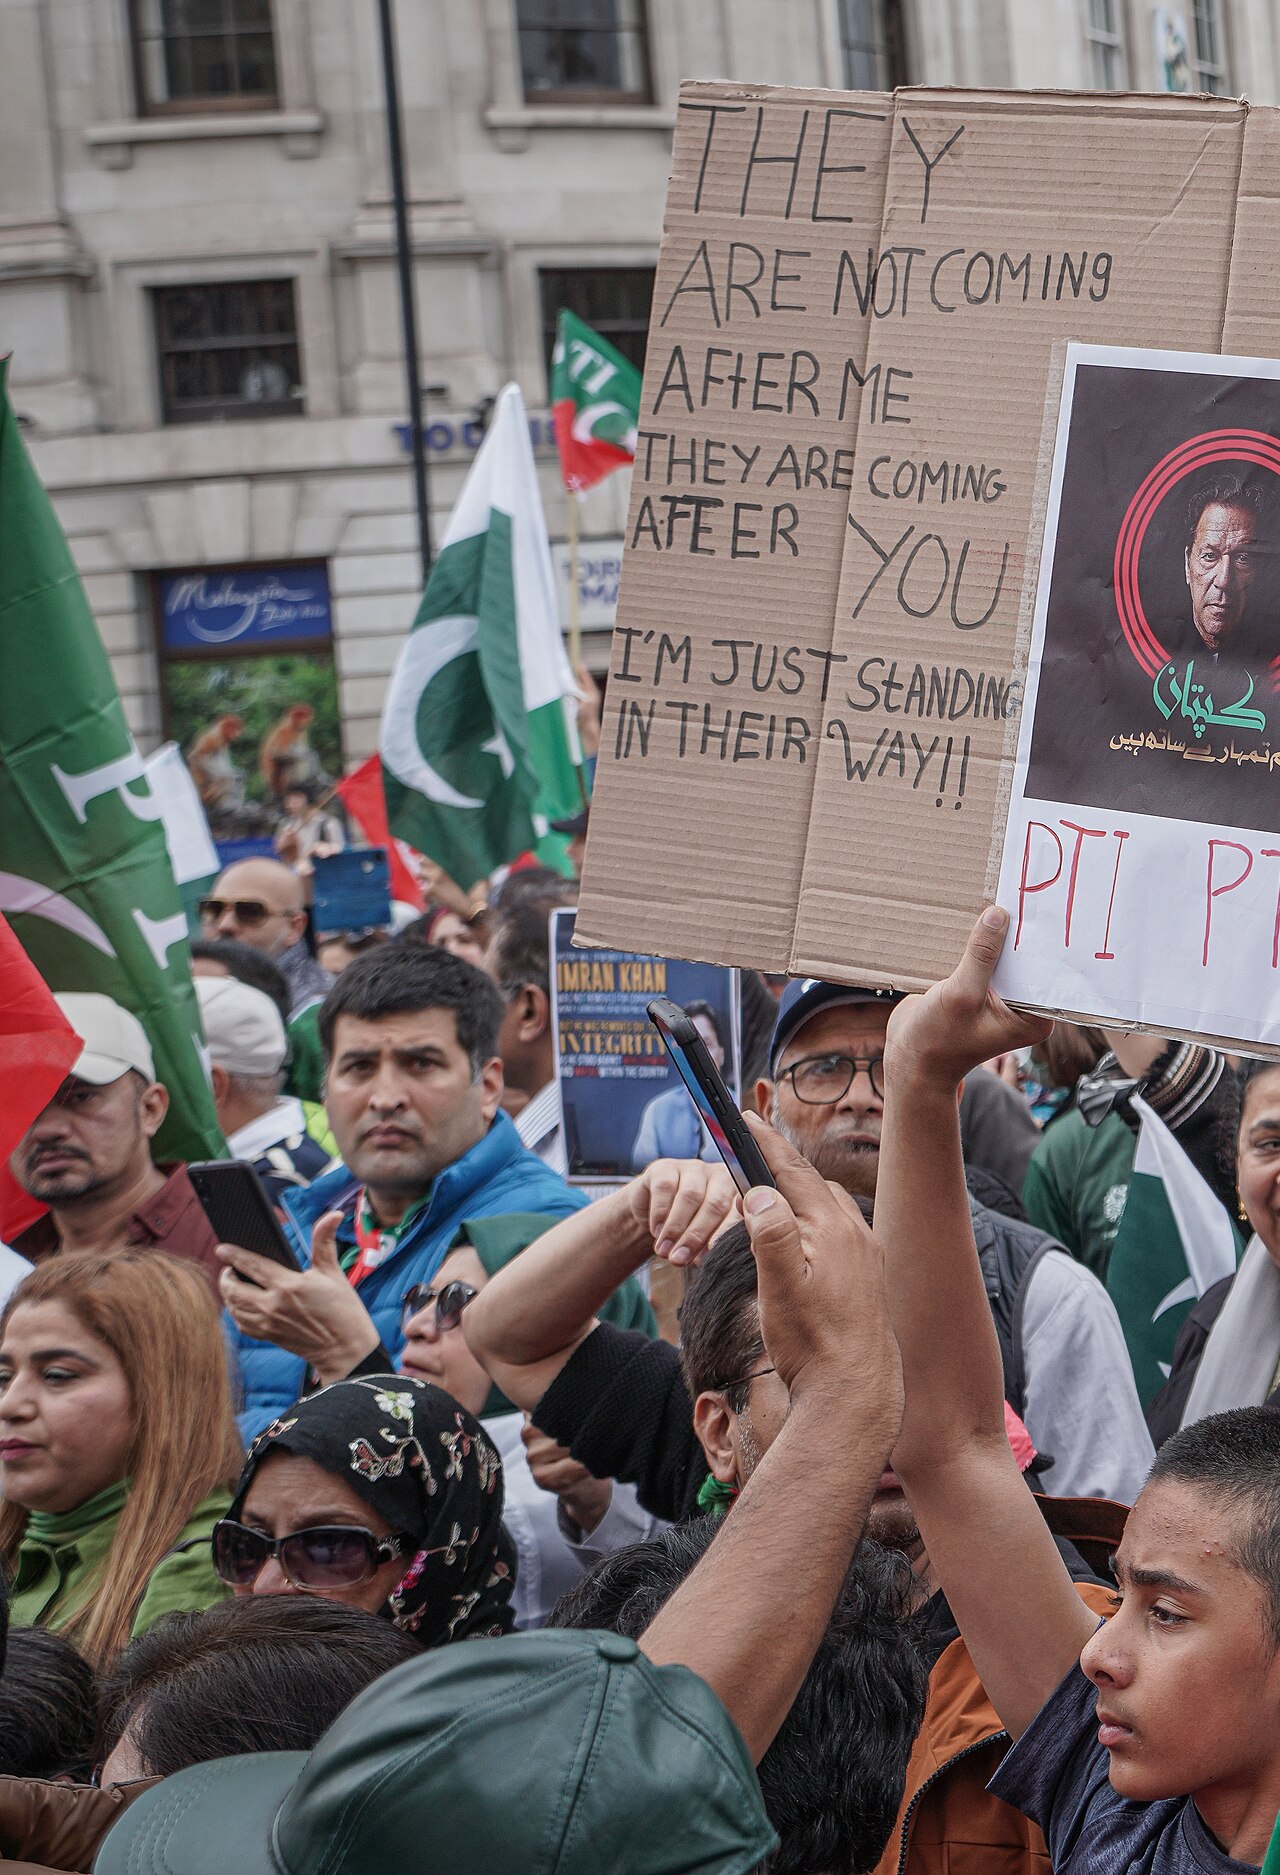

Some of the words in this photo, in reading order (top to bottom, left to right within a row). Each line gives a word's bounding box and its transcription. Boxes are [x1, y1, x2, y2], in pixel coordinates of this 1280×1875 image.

[679, 102, 965, 224] THEY
[660, 240, 812, 328] ARE
[833, 246, 925, 318] NOT
[930, 248, 1114, 313] COMING
[839, 358, 914, 424] ME
[638, 430, 761, 487] THEY
[766, 444, 856, 491] ARE
[868, 455, 1008, 503] COMING
[848, 512, 1010, 630] YOU
[614, 626, 691, 684] I'M
[711, 640, 848, 702] JUST
[1153, 660, 1266, 739] کپتان
[615, 700, 656, 760] IN
[665, 701, 812, 764] THEIR
[826, 719, 971, 811] WAY!!
[1109, 731, 1144, 756] ہیں
[1014, 819, 1130, 960] PTI
[557, 961, 615, 992] IMRAN
[619, 961, 667, 993] KHAN
[559, 1033, 666, 1056] INTEGRITY
